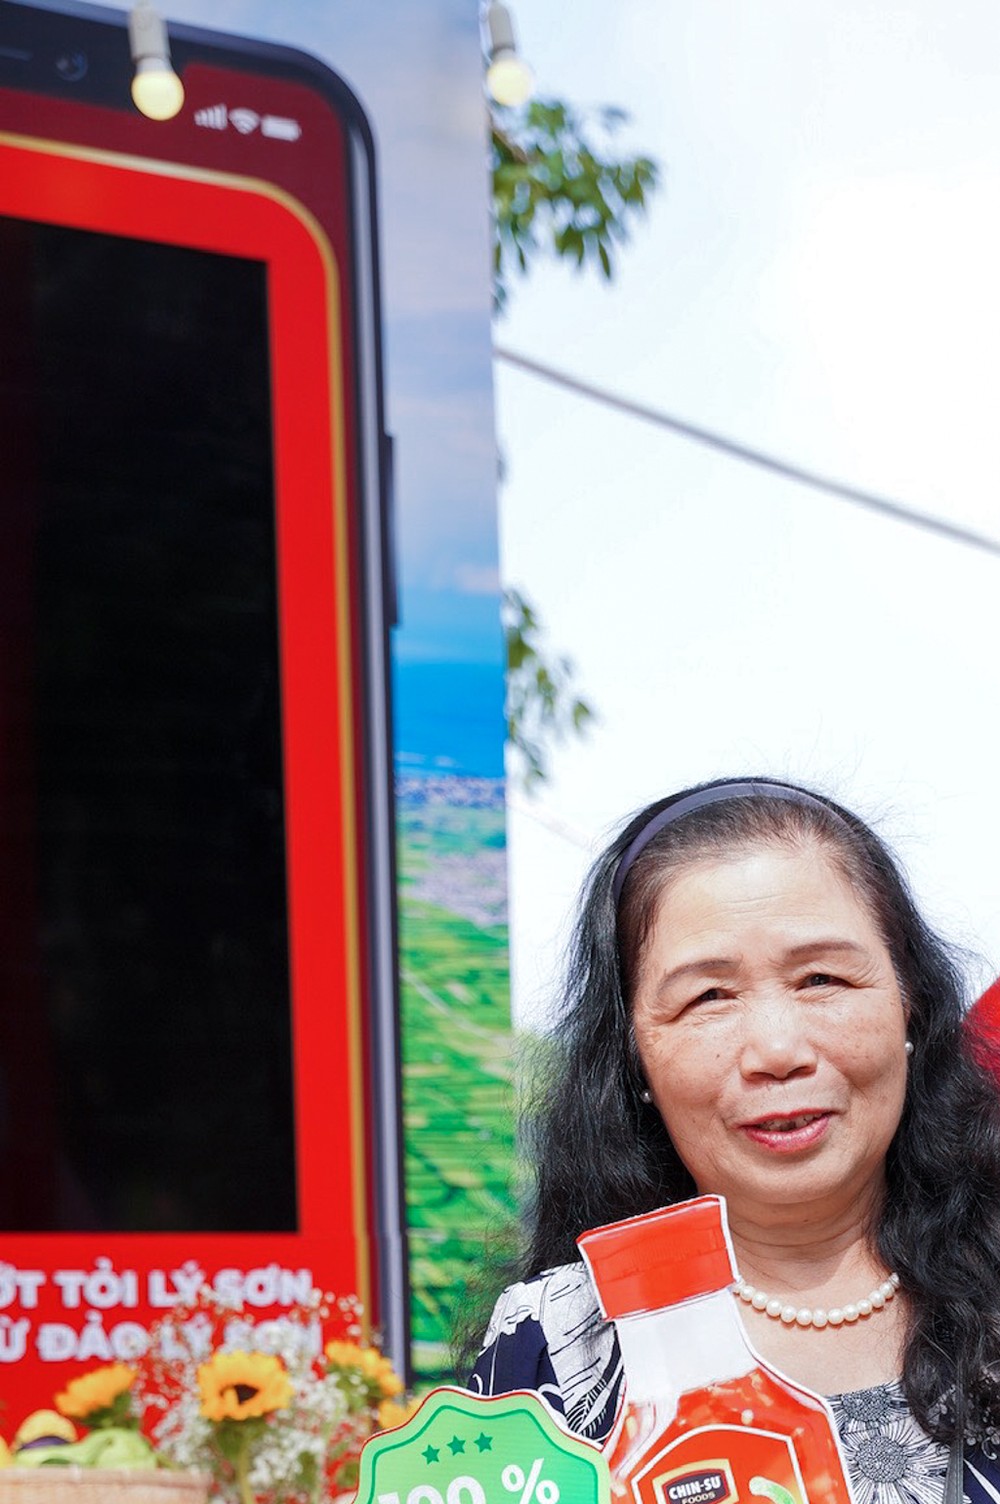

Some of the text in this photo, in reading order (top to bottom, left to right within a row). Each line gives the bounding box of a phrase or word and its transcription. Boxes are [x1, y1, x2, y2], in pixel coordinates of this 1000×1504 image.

[53, 1256, 138, 1309] TỎI
[148, 1260, 204, 1307] LÝ
[669, 1475, 721, 1500] CHIN-SU
